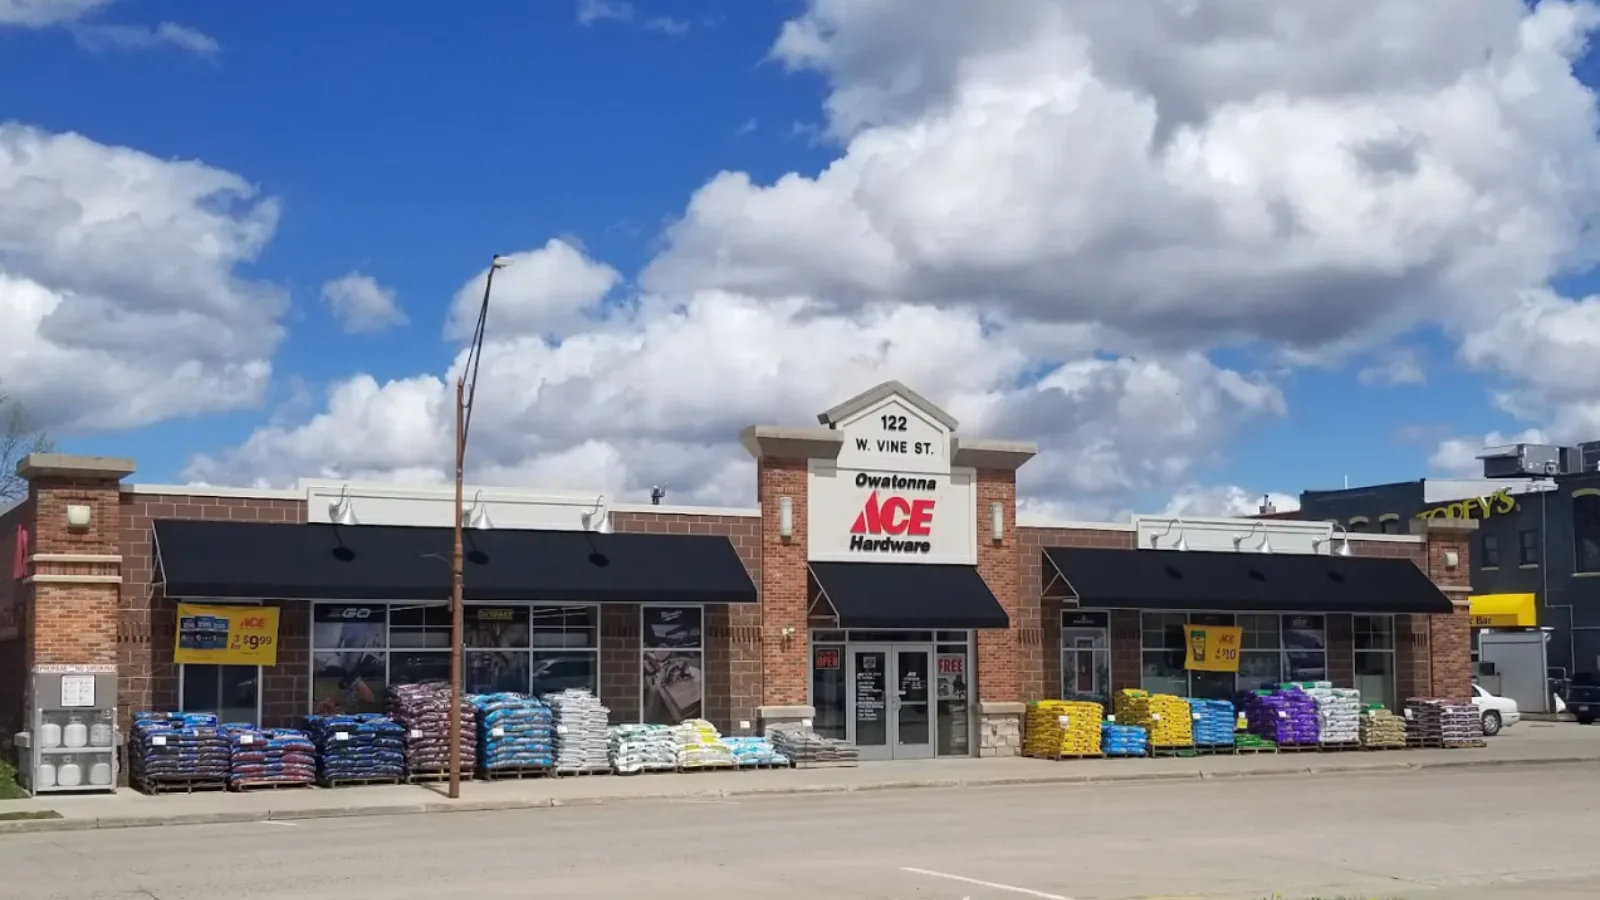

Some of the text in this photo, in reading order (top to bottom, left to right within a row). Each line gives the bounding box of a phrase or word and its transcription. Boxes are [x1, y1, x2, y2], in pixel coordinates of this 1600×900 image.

[880, 415, 907, 431] 122
[856, 438, 934, 455] W. VINE ST.
[855, 472, 936, 490] Owatonna
[850, 490, 935, 536] ACE
[850, 535, 931, 554] Hardware
[239, 616, 266, 629] ACE
[1476, 616, 1492, 624] Bar
[233, 634, 240, 642] 3
[816, 655, 838, 667] OPEN
[939, 659, 963, 673] FREE
